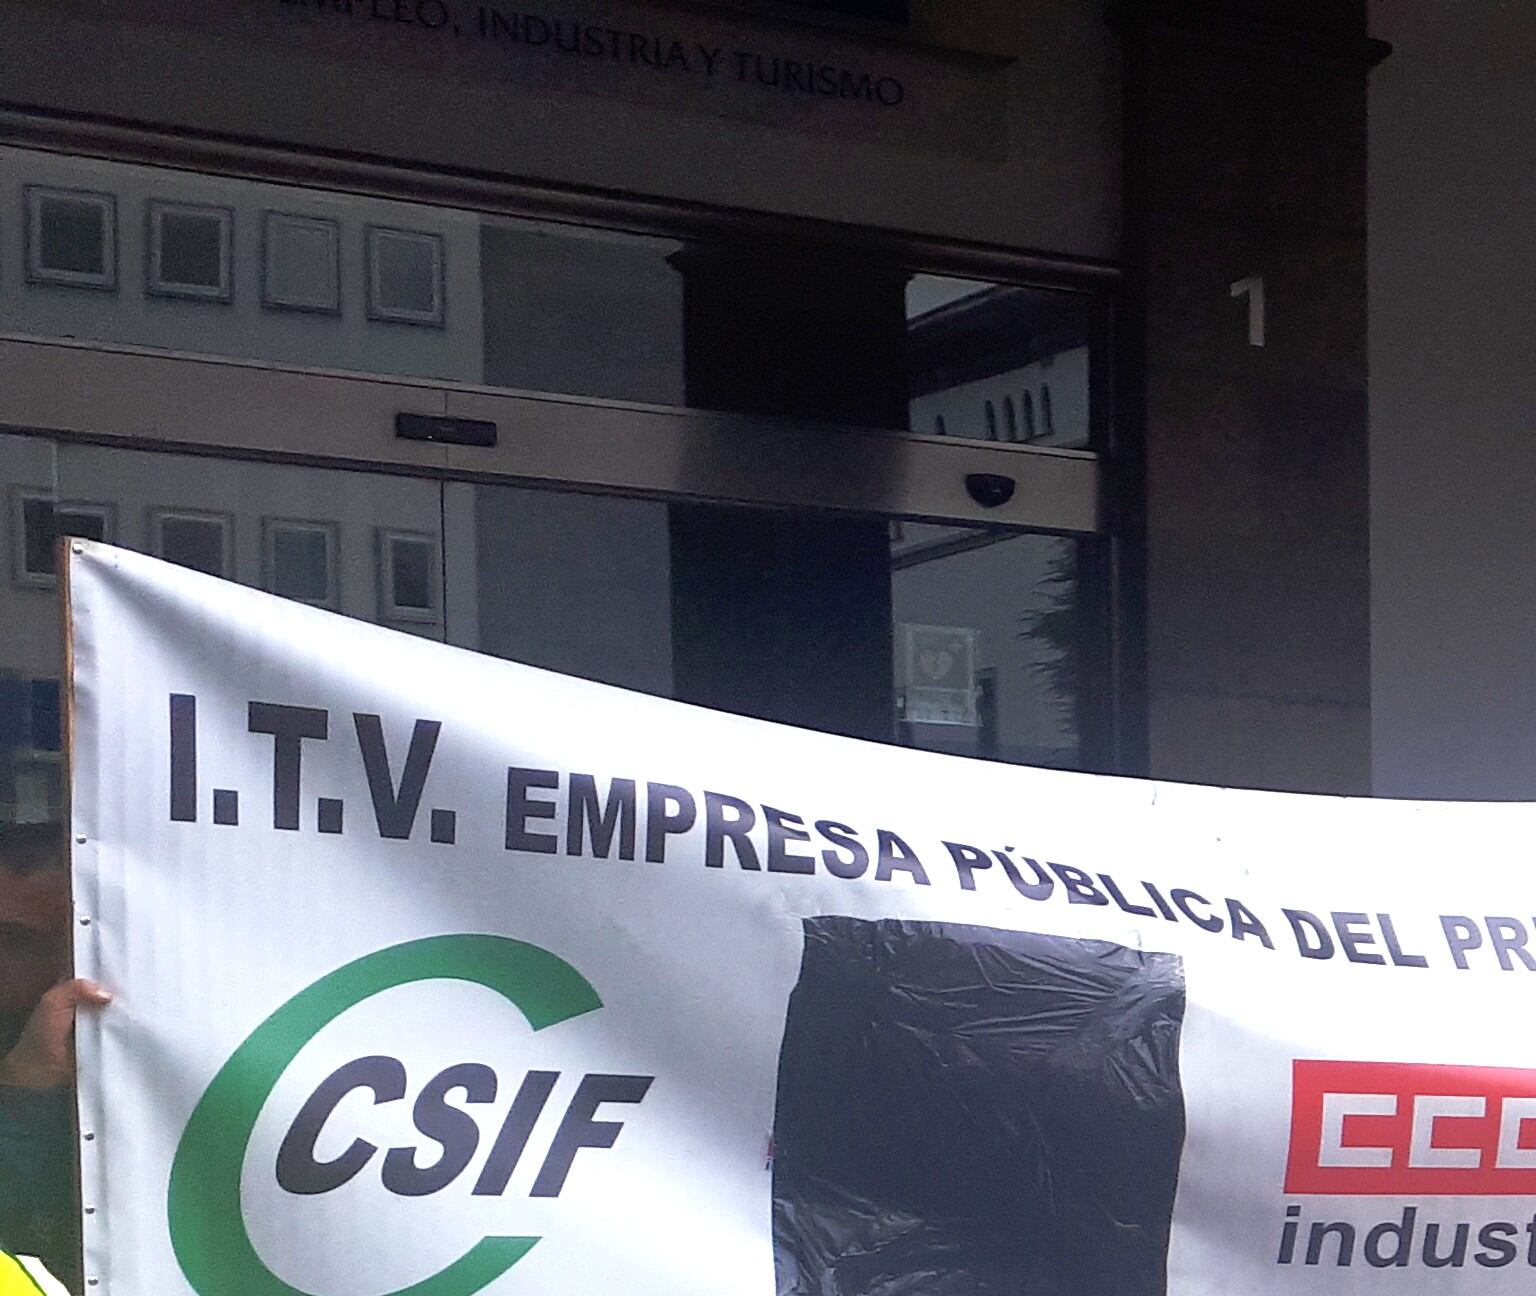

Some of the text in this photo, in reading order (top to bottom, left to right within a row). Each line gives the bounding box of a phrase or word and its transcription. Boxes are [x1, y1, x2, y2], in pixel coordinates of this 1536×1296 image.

[479, 6, 690, 74] INDUSTRIA
[698, 44, 721, 77] Y
[731, 50, 904, 107] TURISMO
[1230, 275, 1267, 348] 1
[169, 693, 457, 845] I.T.V.
[504, 766, 931, 887] EMPRESA
[942, 840, 1275, 951] PÚBLICA
[1281, 907, 1429, 969] DEL
[275, 1055, 655, 1198] CSIF
